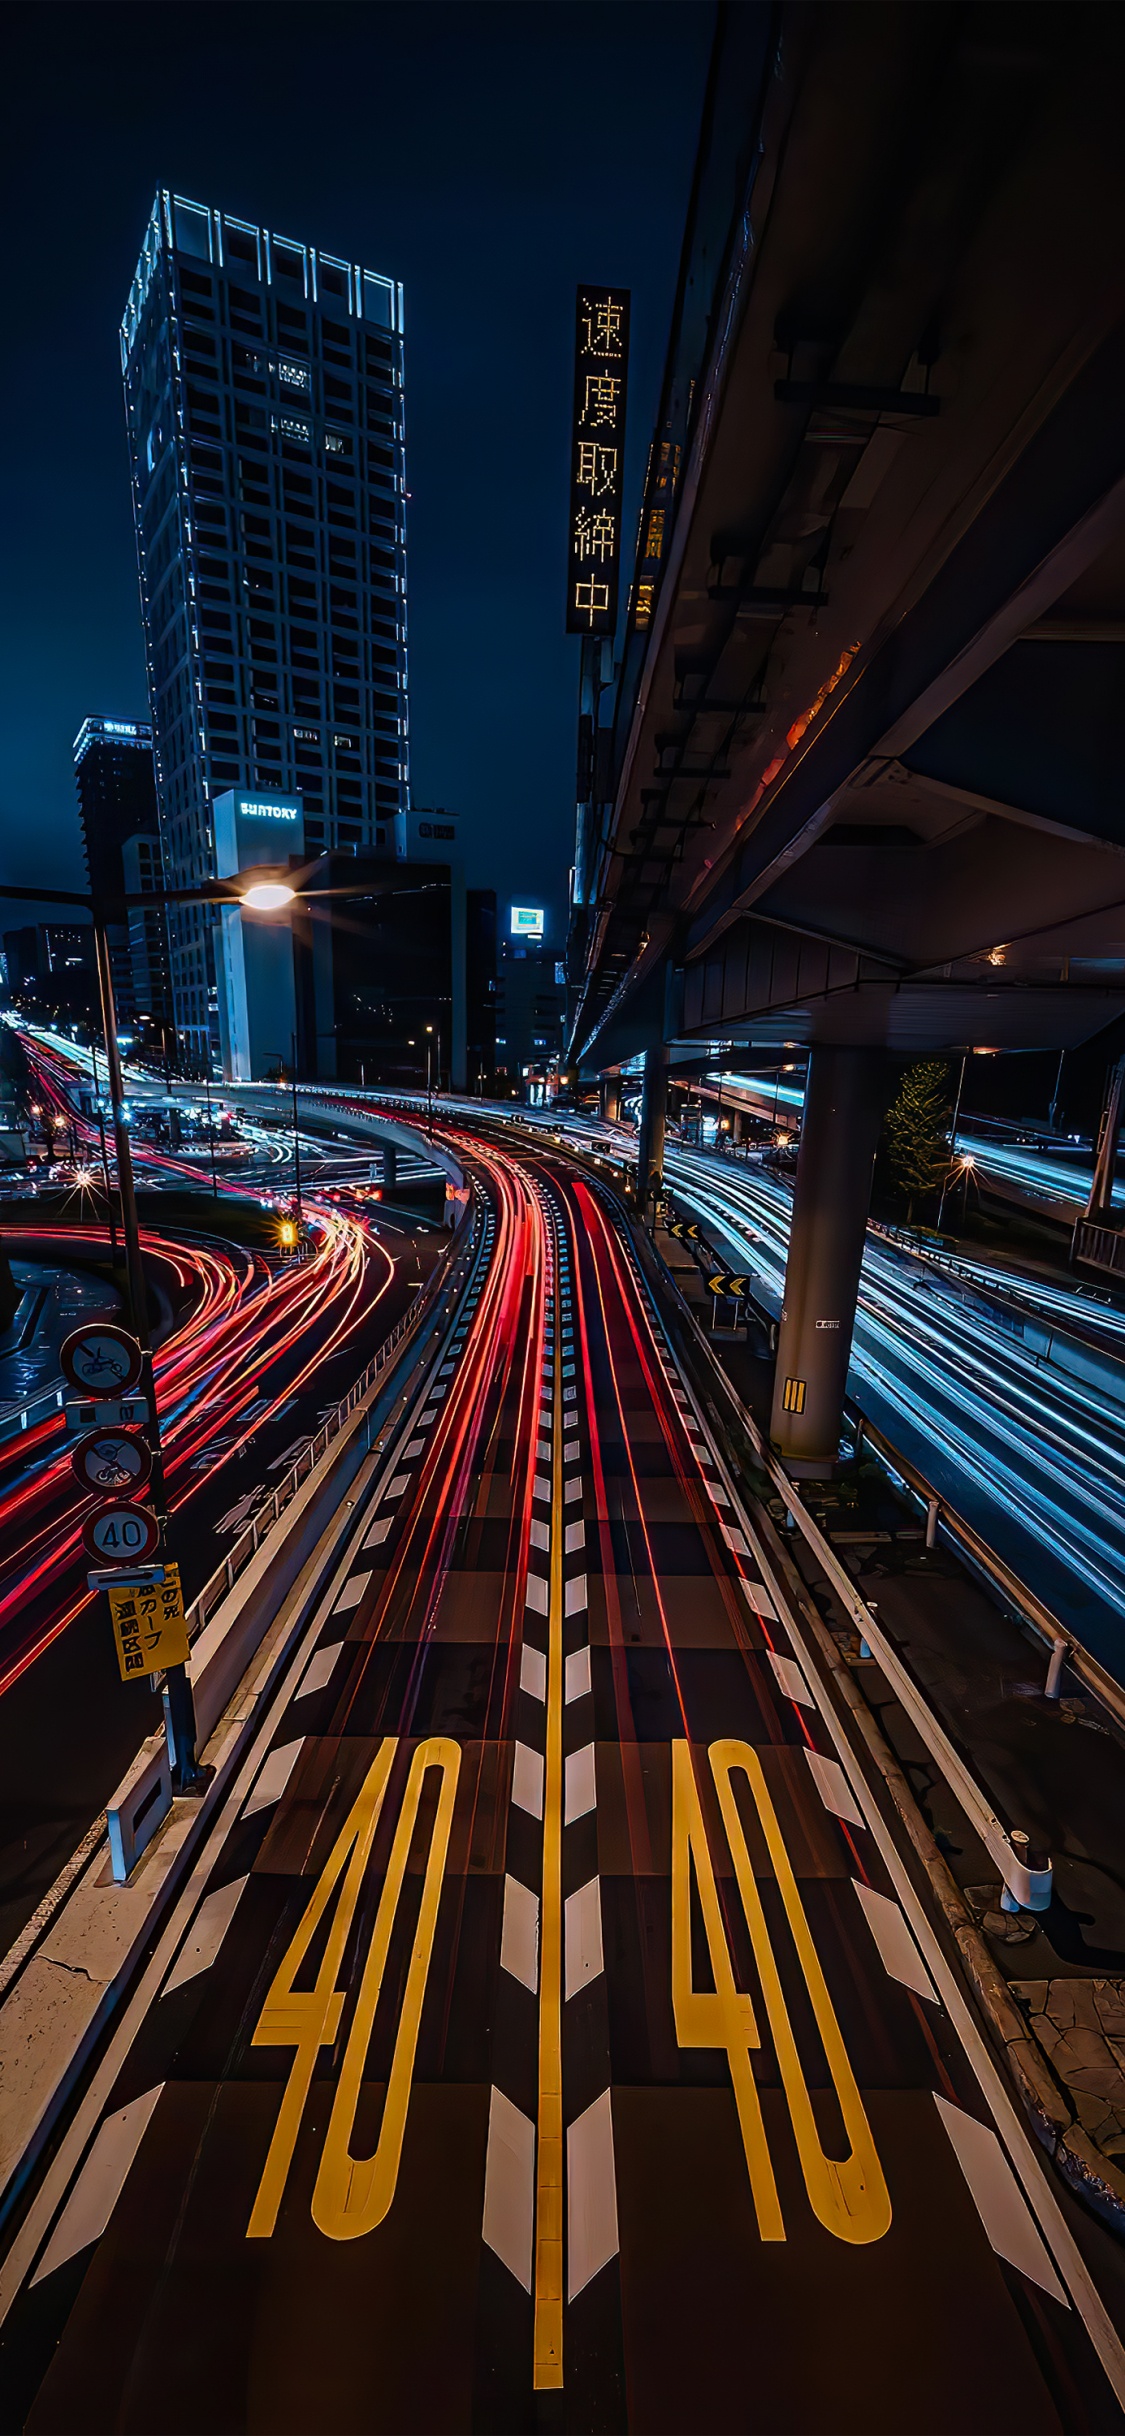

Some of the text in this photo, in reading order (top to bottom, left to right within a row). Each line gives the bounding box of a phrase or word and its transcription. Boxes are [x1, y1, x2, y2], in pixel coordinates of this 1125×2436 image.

[575, 296, 623, 627] 速度取締中
[240, 803, 297, 819] SUNTORY
[102, 1521, 141, 1548] 40
[246, 1737, 462, 2240] 40
[672, 1738, 892, 2244] 40
